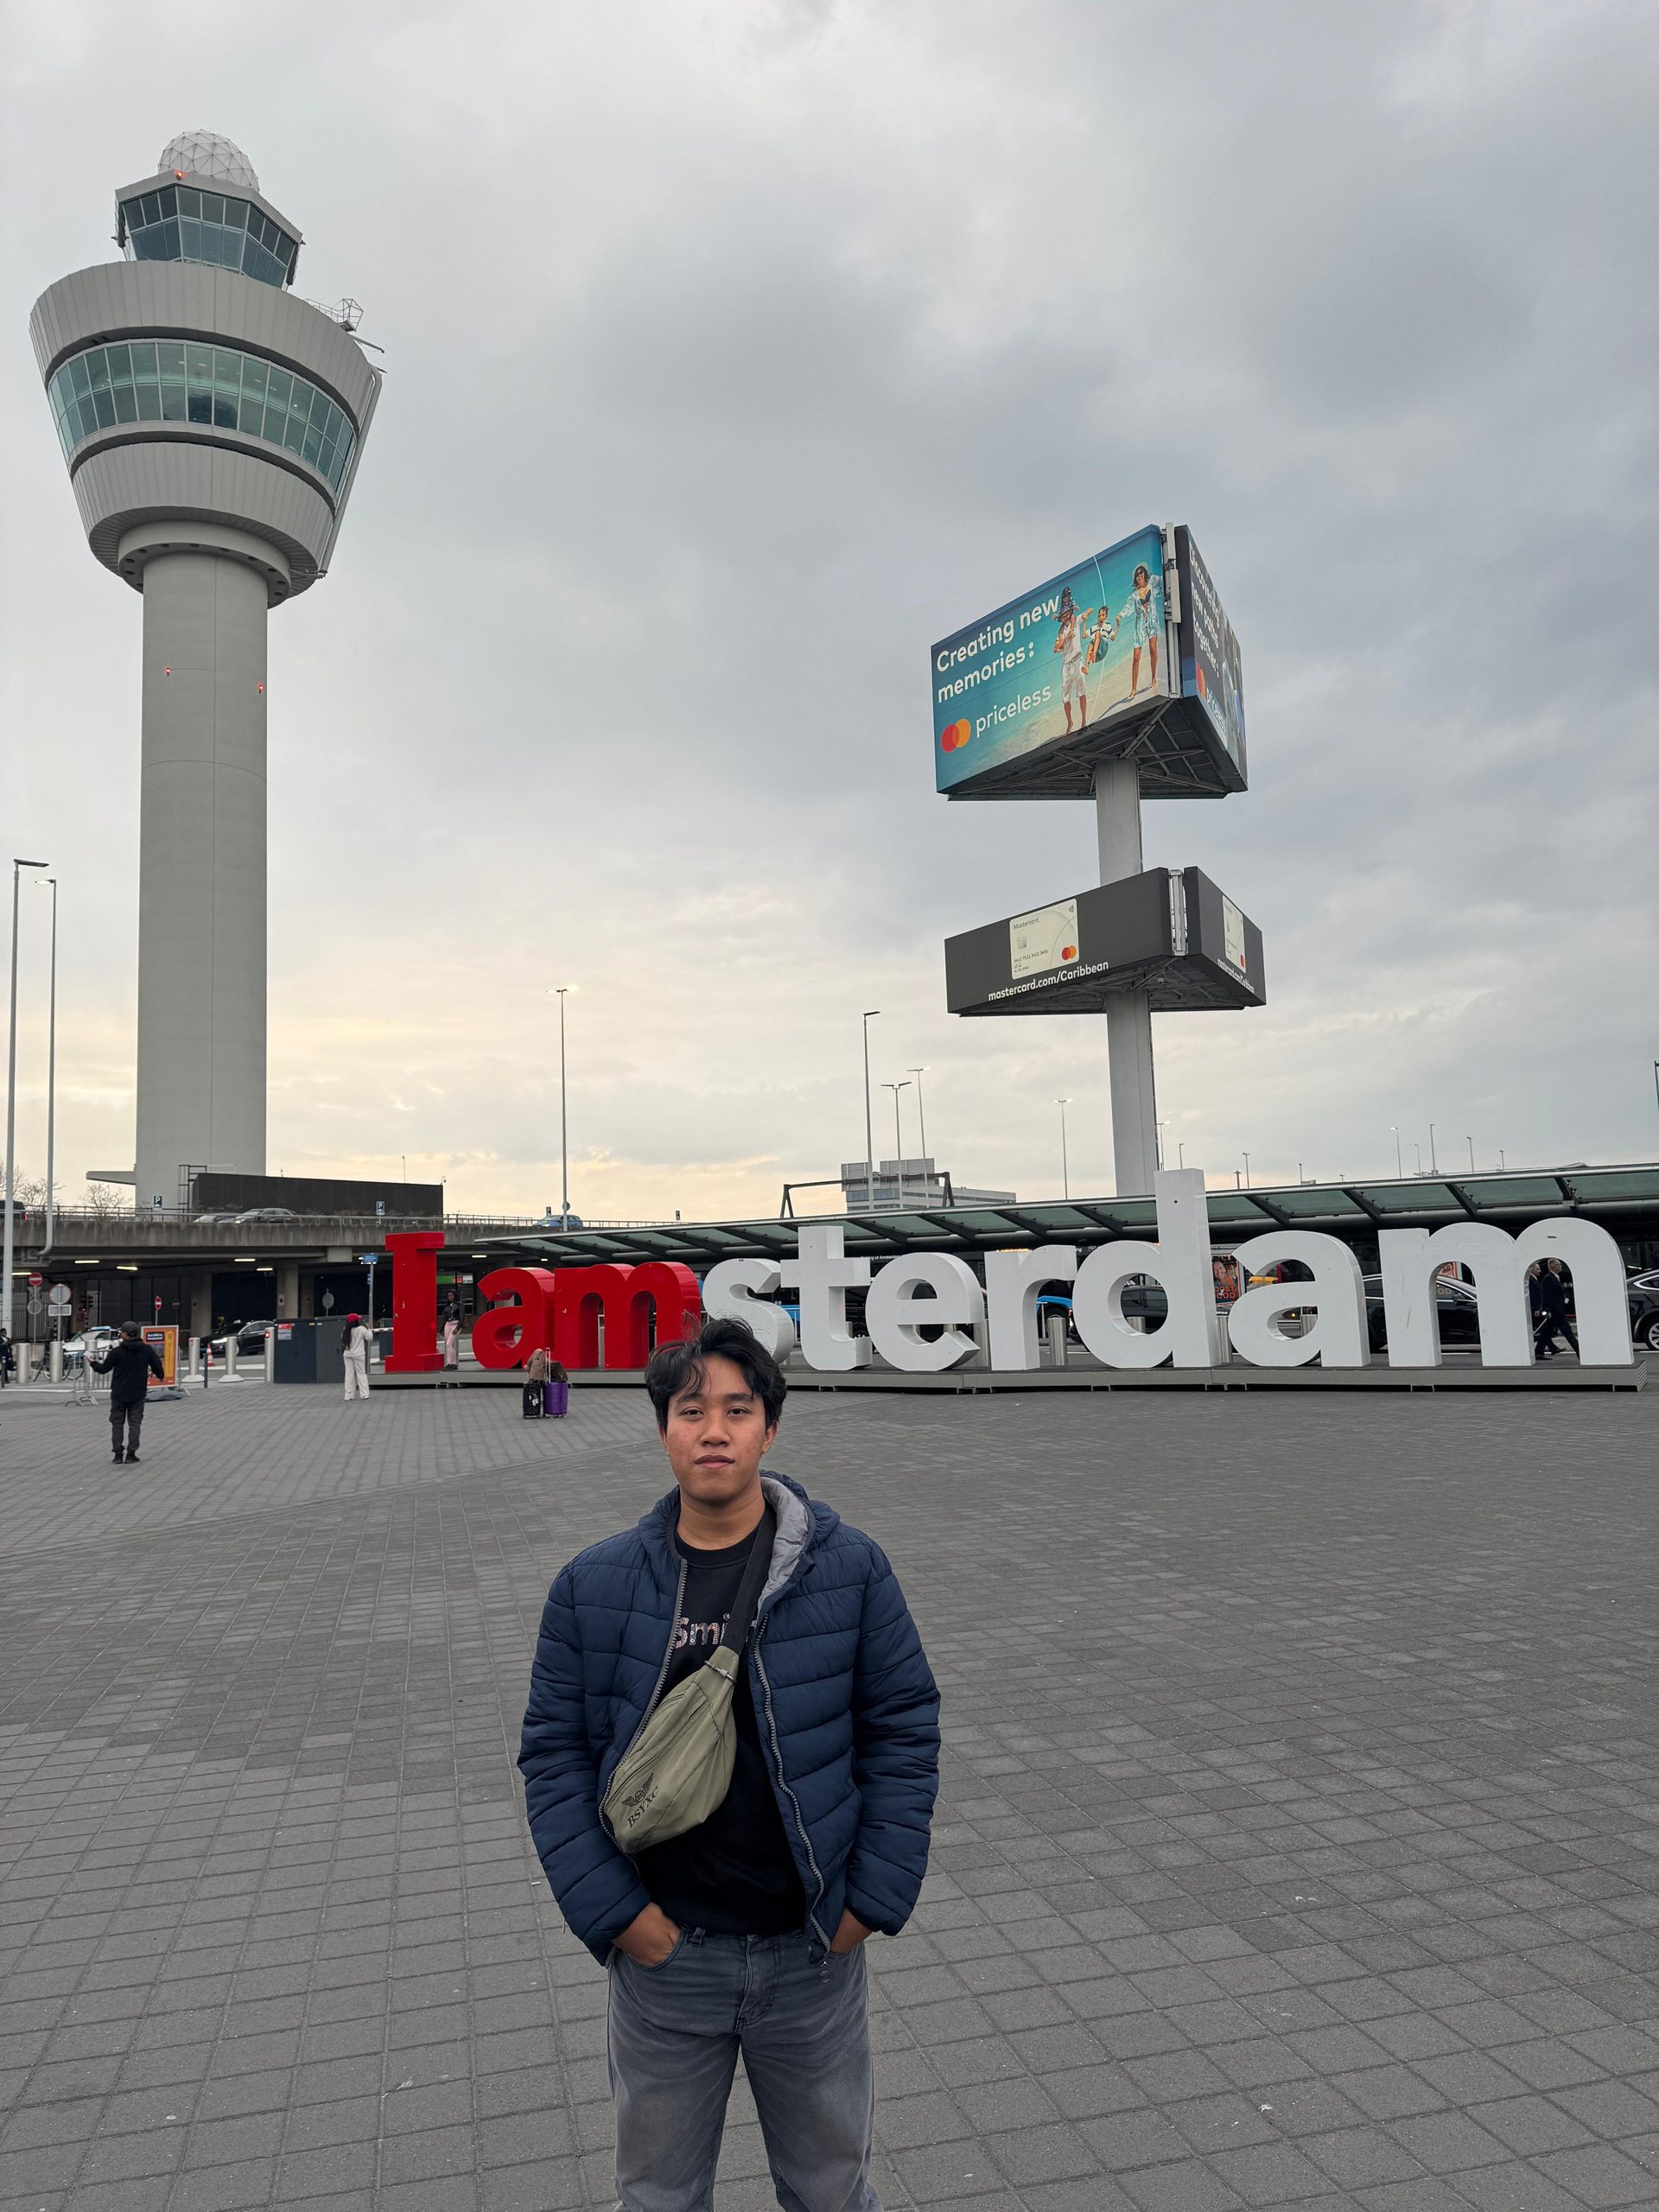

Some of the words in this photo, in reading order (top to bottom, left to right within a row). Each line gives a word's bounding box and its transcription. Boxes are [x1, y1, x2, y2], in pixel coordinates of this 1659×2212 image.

[937, 625, 1014, 672] Creating
[1020, 594, 1060, 630] new
[938, 641, 1034, 703] memories:
[976, 685, 1052, 738] priceless
[988, 960, 1109, 1001] mastercard.com/Caribbean
